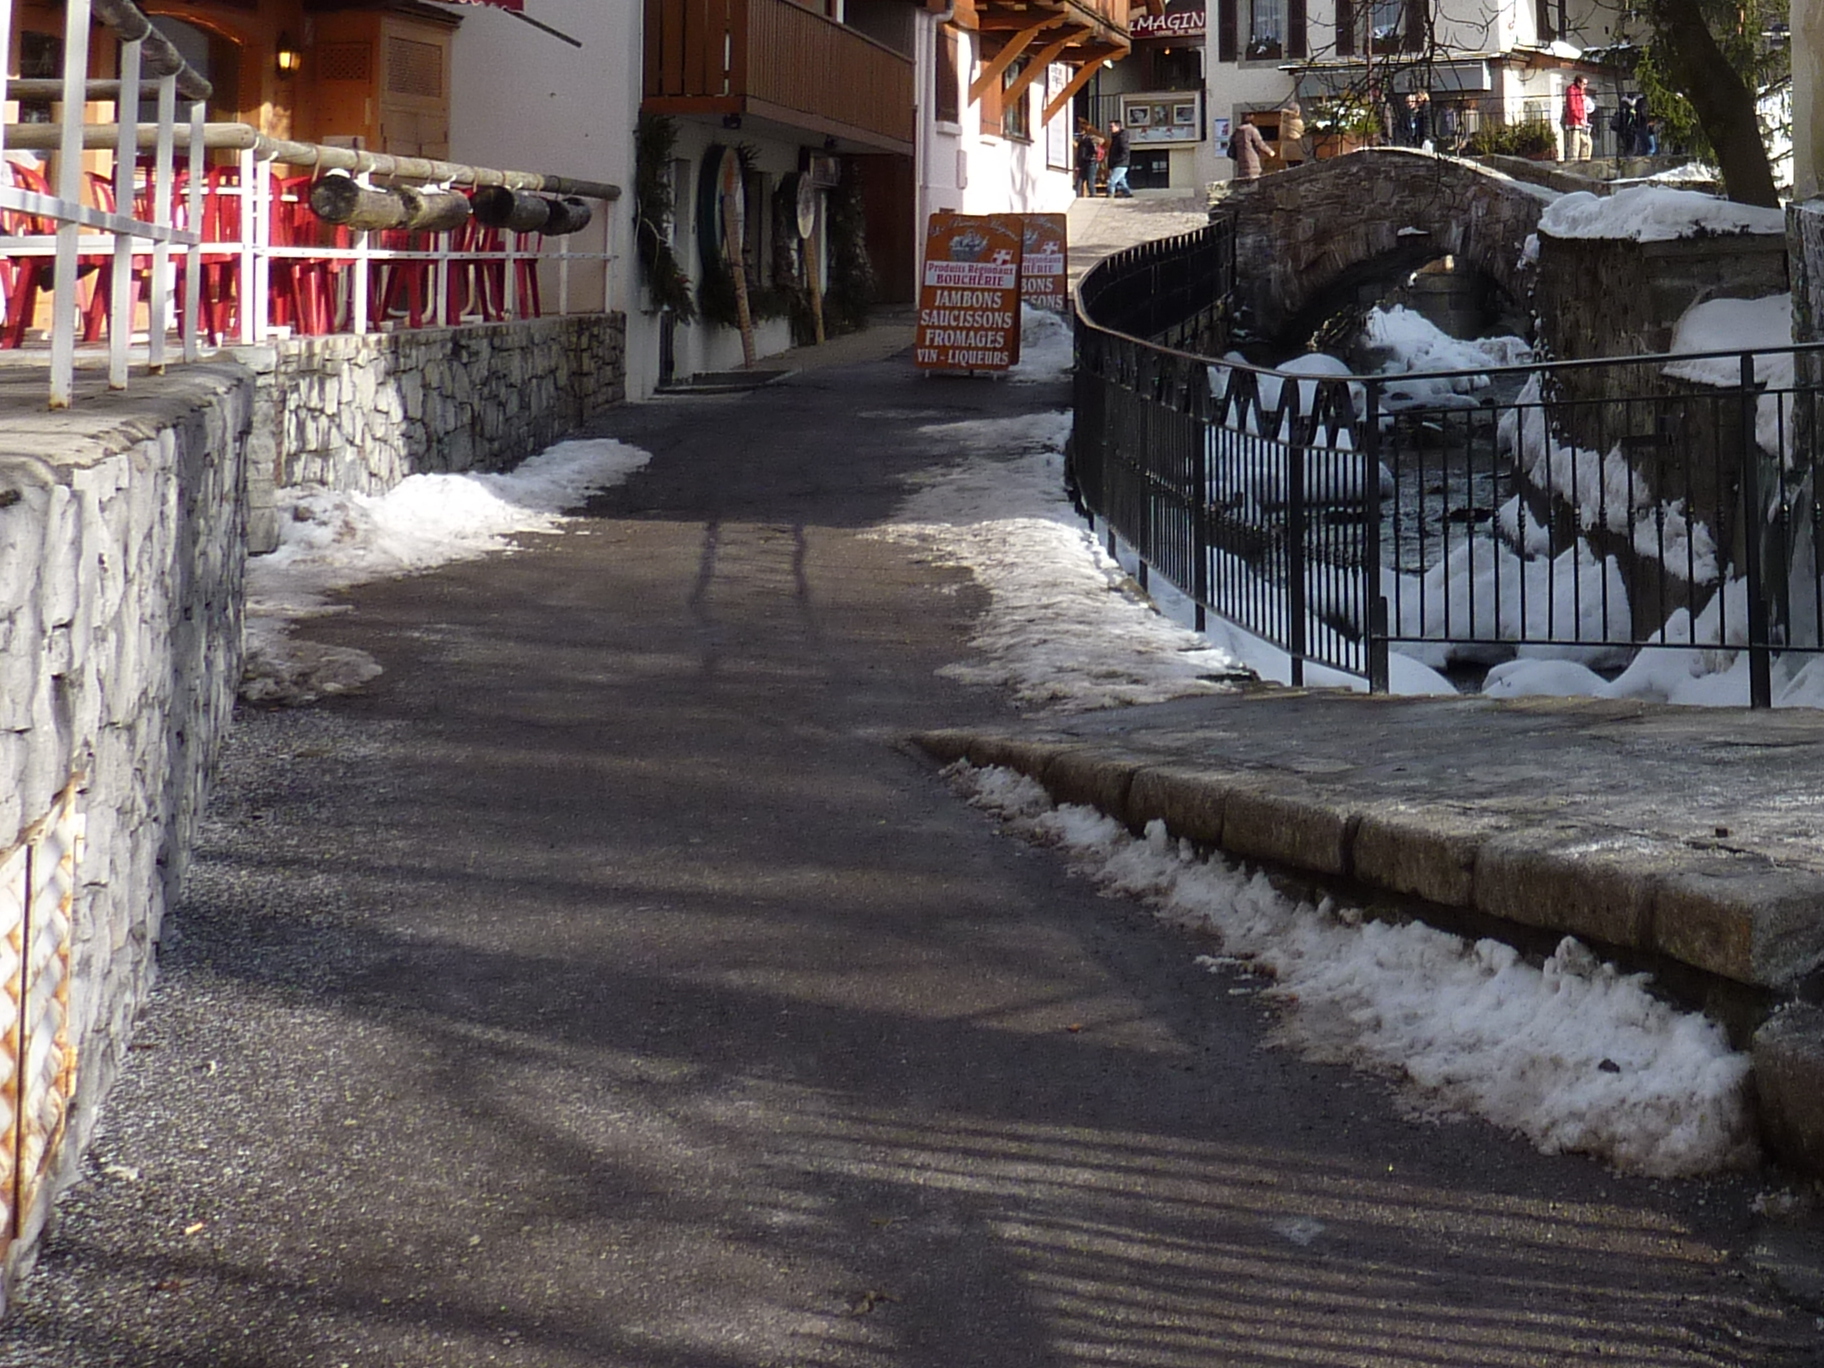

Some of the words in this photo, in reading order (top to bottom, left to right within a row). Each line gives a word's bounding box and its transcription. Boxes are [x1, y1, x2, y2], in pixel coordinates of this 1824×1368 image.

[928, 262, 965, 273] Produits
[967, 263, 1015, 277] Régionaux
[1021, 278, 1054, 293] BONS
[934, 290, 1003, 309] JAMBONS
[920, 309, 1013, 329] SAUCISSONS
[924, 328, 1005, 349] FROMAGES
[916, 348, 938, 363] VIN
[947, 349, 1009, 367] LIQUEURS
